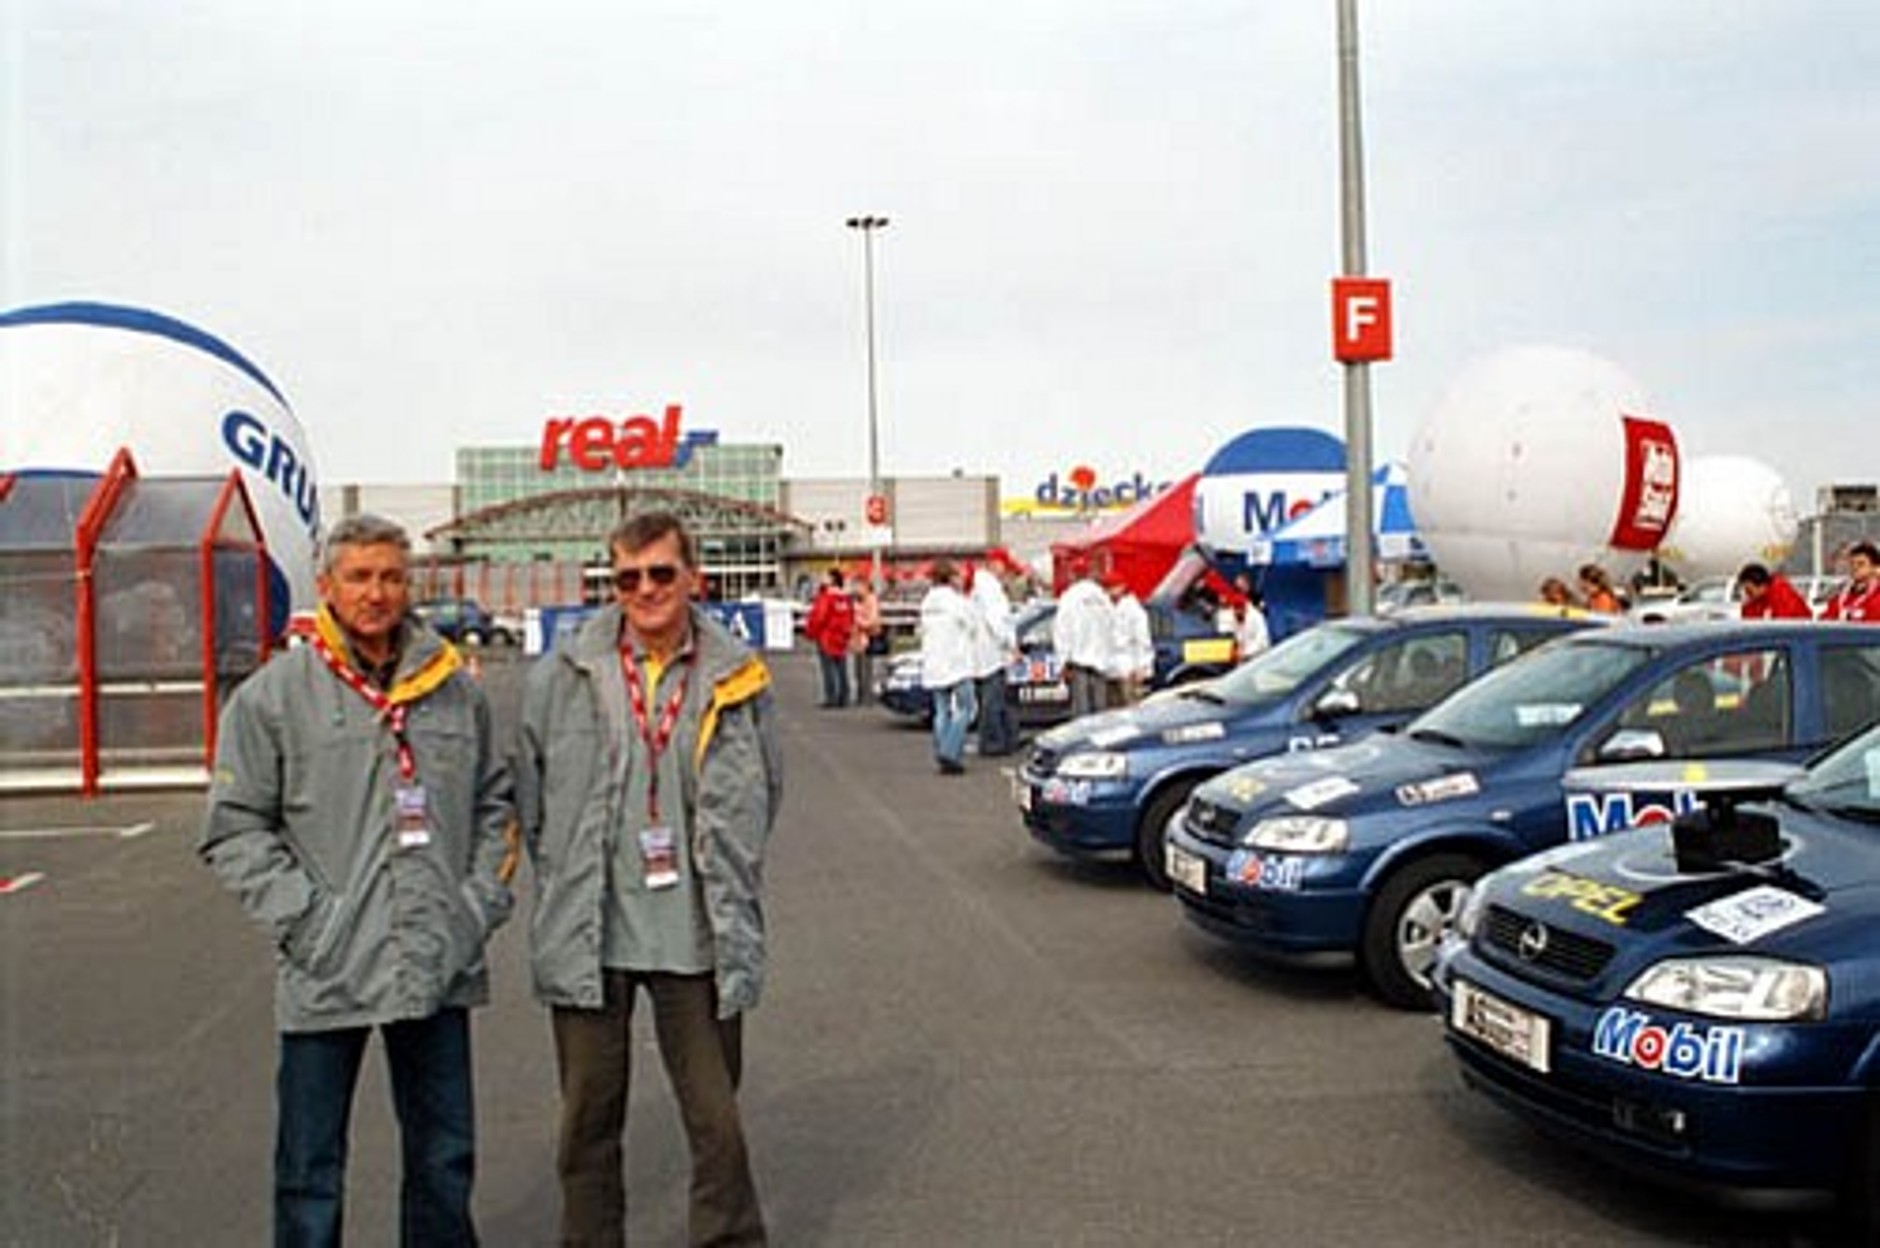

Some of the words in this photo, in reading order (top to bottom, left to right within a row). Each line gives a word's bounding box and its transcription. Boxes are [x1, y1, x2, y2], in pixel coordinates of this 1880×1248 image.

[1347, 297, 1377, 340] F
[222, 410, 319, 532] GRU
[1593, 1007, 1744, 1083] Mobil
